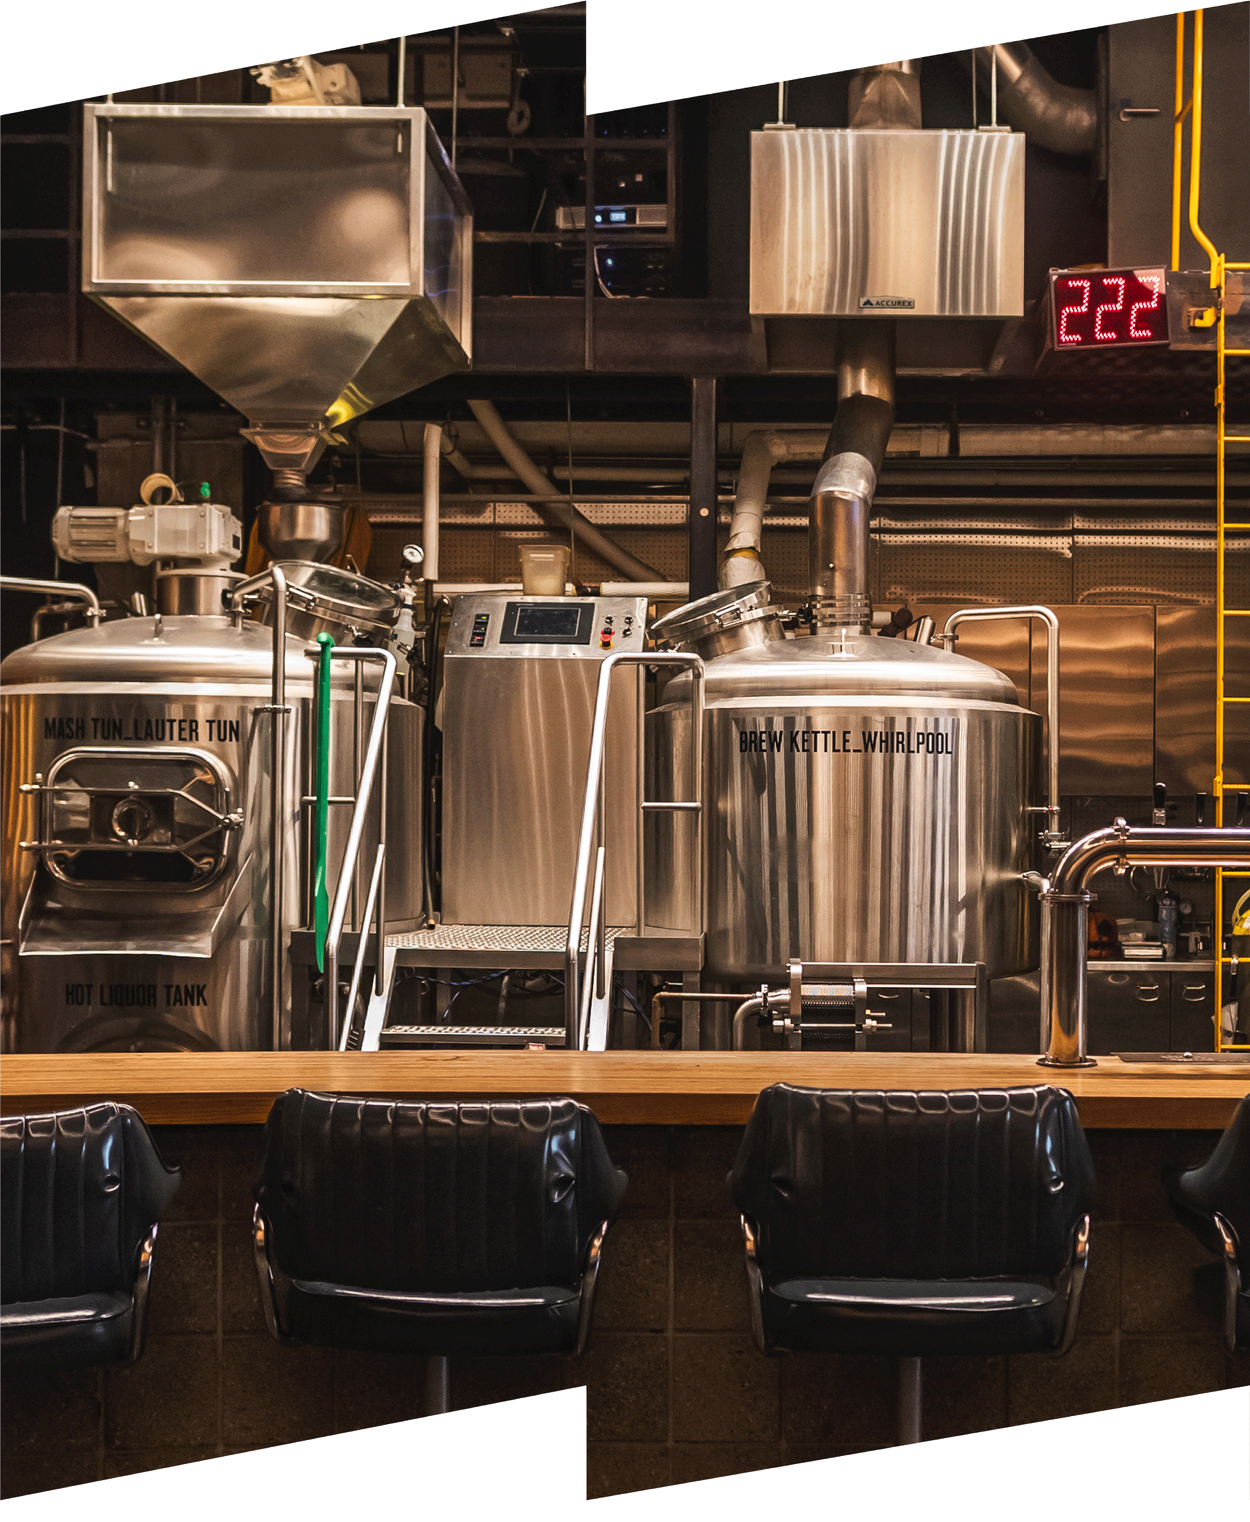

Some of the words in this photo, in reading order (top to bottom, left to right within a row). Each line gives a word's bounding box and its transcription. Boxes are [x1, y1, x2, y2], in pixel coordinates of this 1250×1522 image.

[44, 717, 85, 740] MASH
[91, 717, 199, 742] TUN_LAUTER
[206, 719, 240, 743] TUN
[739, 730, 783, 753] BREW
[789, 730, 953, 755] KETTLE_WHIRLPOOL
[65, 983, 94, 1006] HOT
[99, 983, 158, 1007] LIQUOR
[163, 984, 208, 1007] TANK
